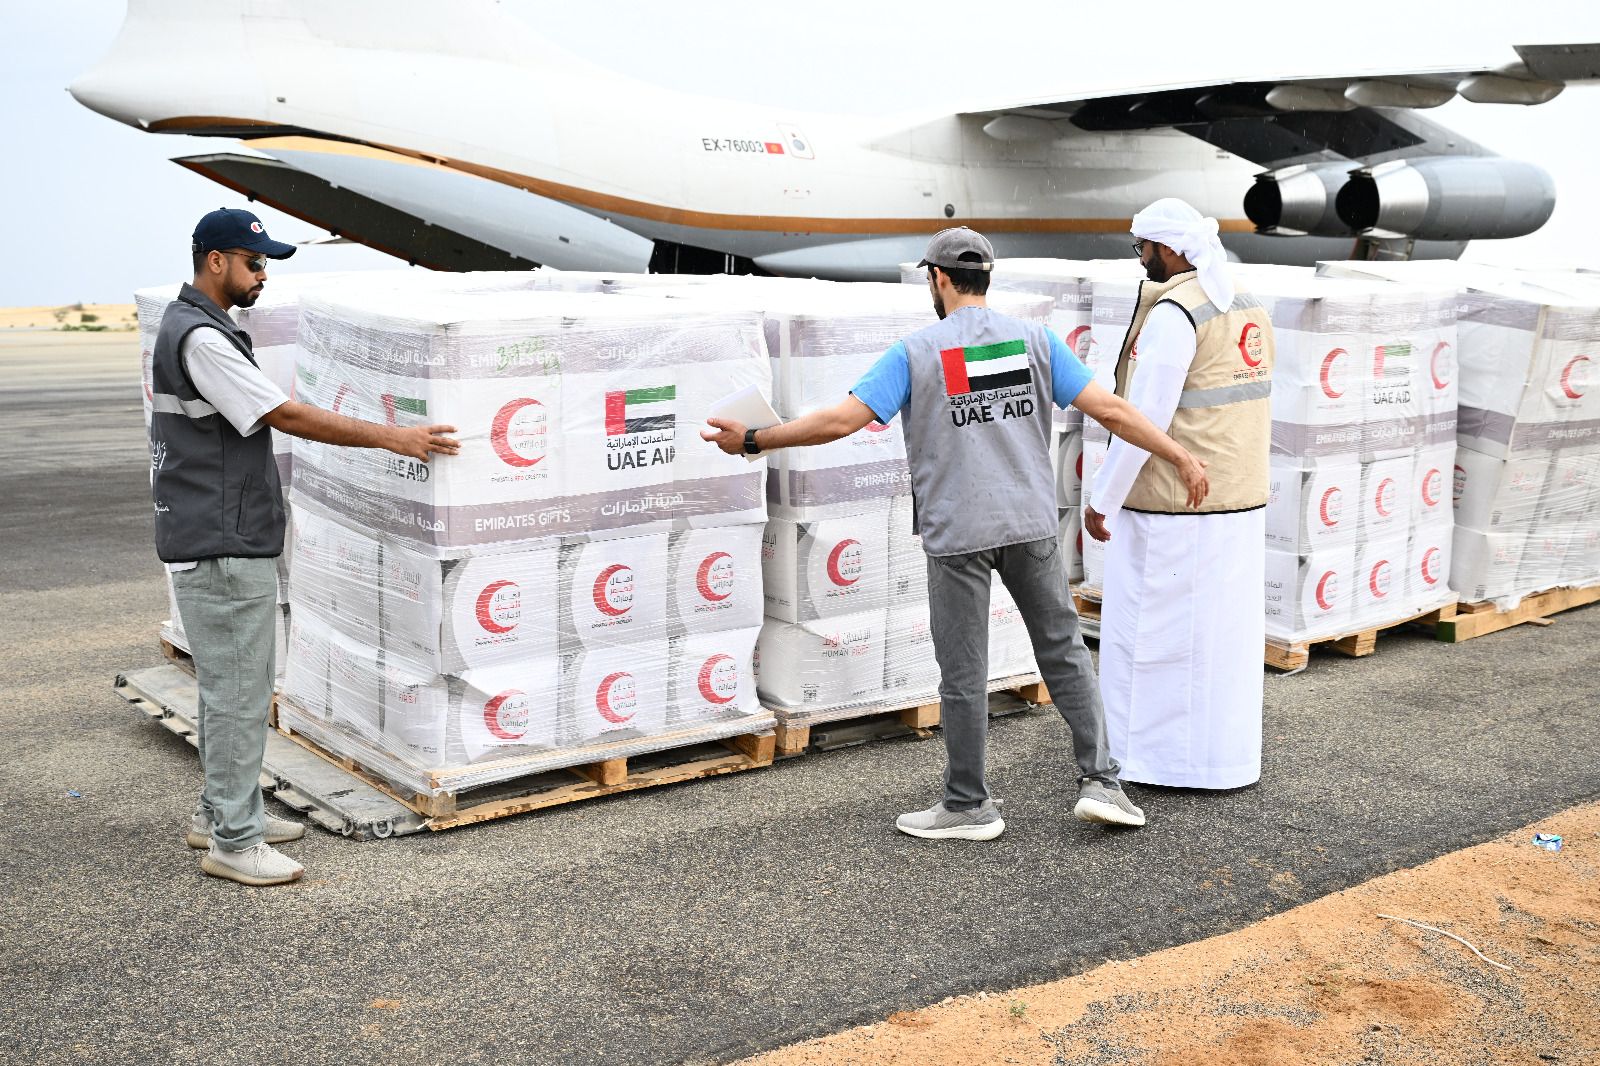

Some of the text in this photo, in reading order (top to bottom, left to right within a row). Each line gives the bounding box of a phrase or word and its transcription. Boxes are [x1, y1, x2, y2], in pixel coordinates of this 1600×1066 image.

[702, 138, 764, 153] EX-76003
[950, 385, 1032, 409] المساعدات الإماراتية
[951, 398, 1034, 428] UAE AID
[607, 449, 648, 471] UAE
[406, 460, 430, 483] AID
[416, 512, 446, 532] هدية
[475, 509, 571, 532] EMIRATES GIFTS
[822, 648, 849, 658] HUMAN
